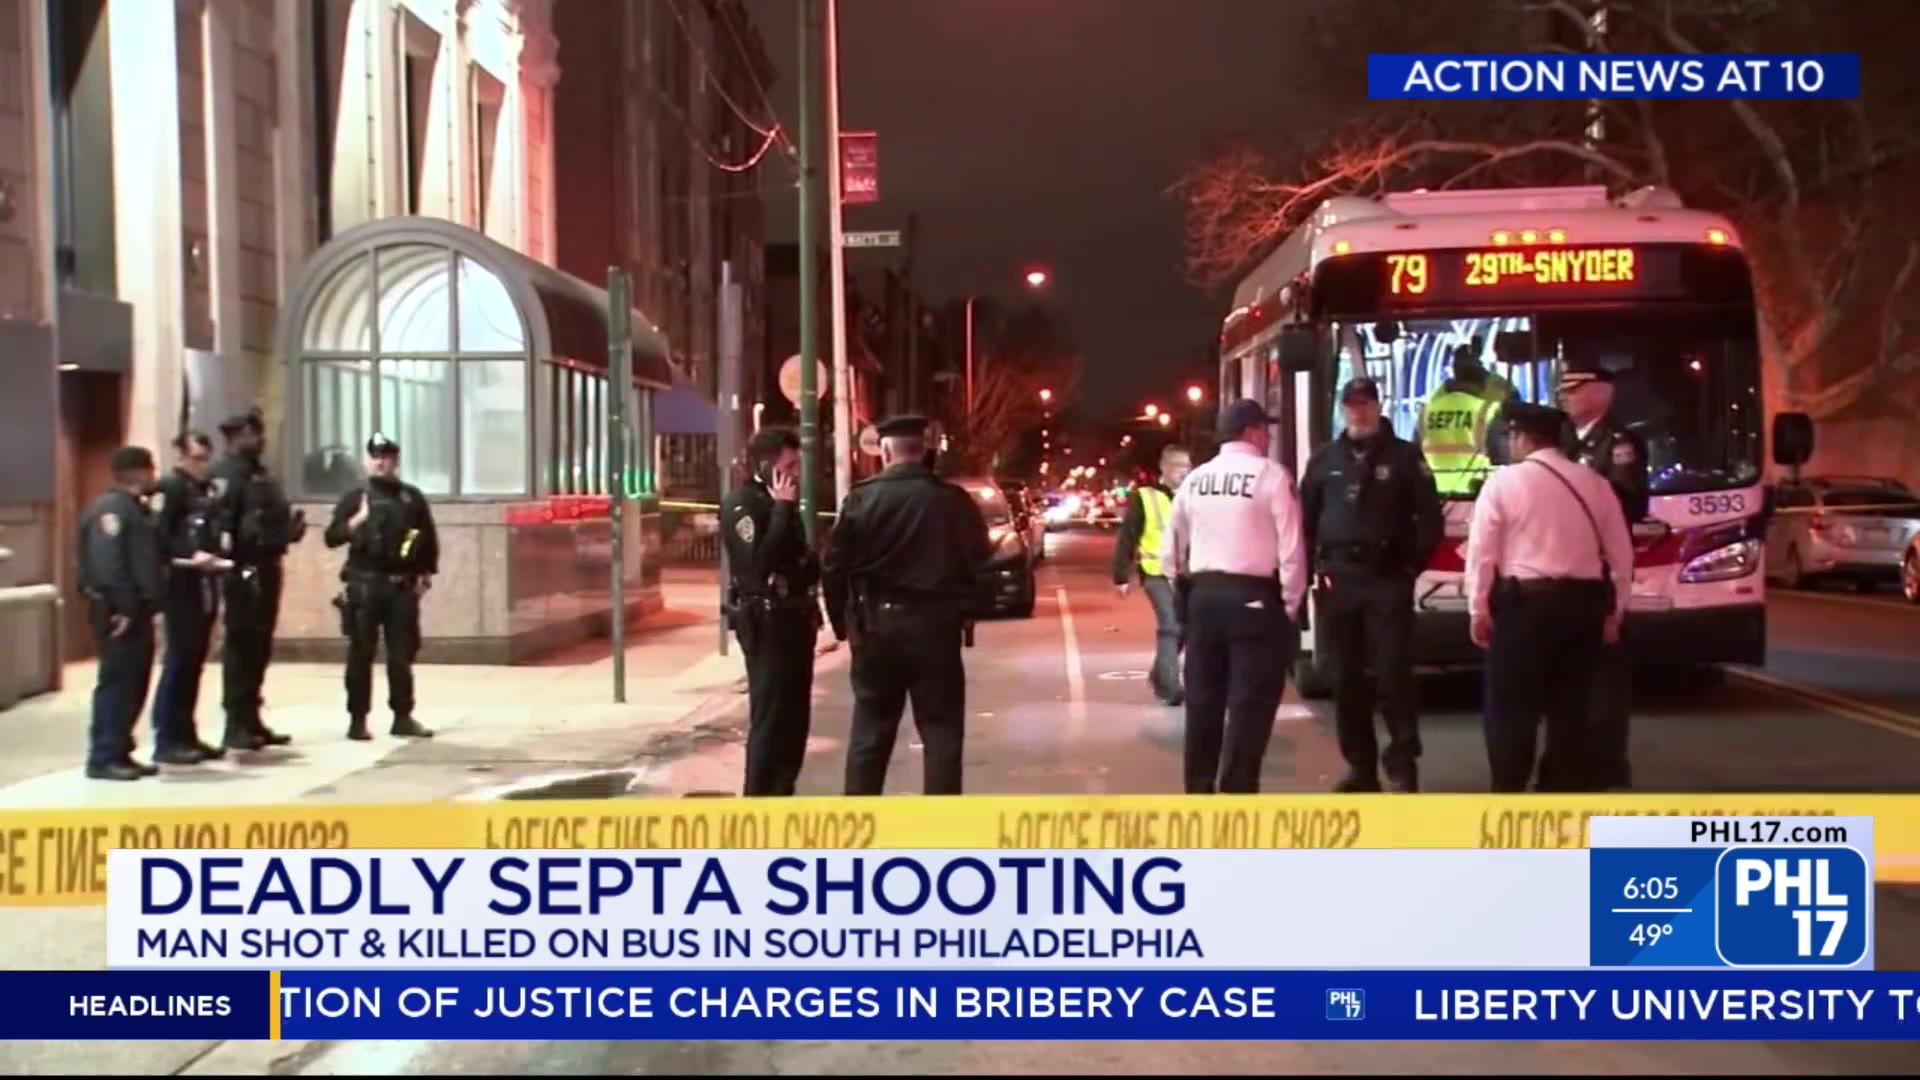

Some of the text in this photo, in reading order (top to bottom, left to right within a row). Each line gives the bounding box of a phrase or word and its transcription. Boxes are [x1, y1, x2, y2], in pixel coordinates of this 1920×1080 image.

[1387, 249, 1633, 293] 79 29TH-SNYDER
[1428, 409, 1473, 429] SEPTA
[1189, 472, 1255, 498] POLICE
[1688, 493, 1745, 515] 3593
